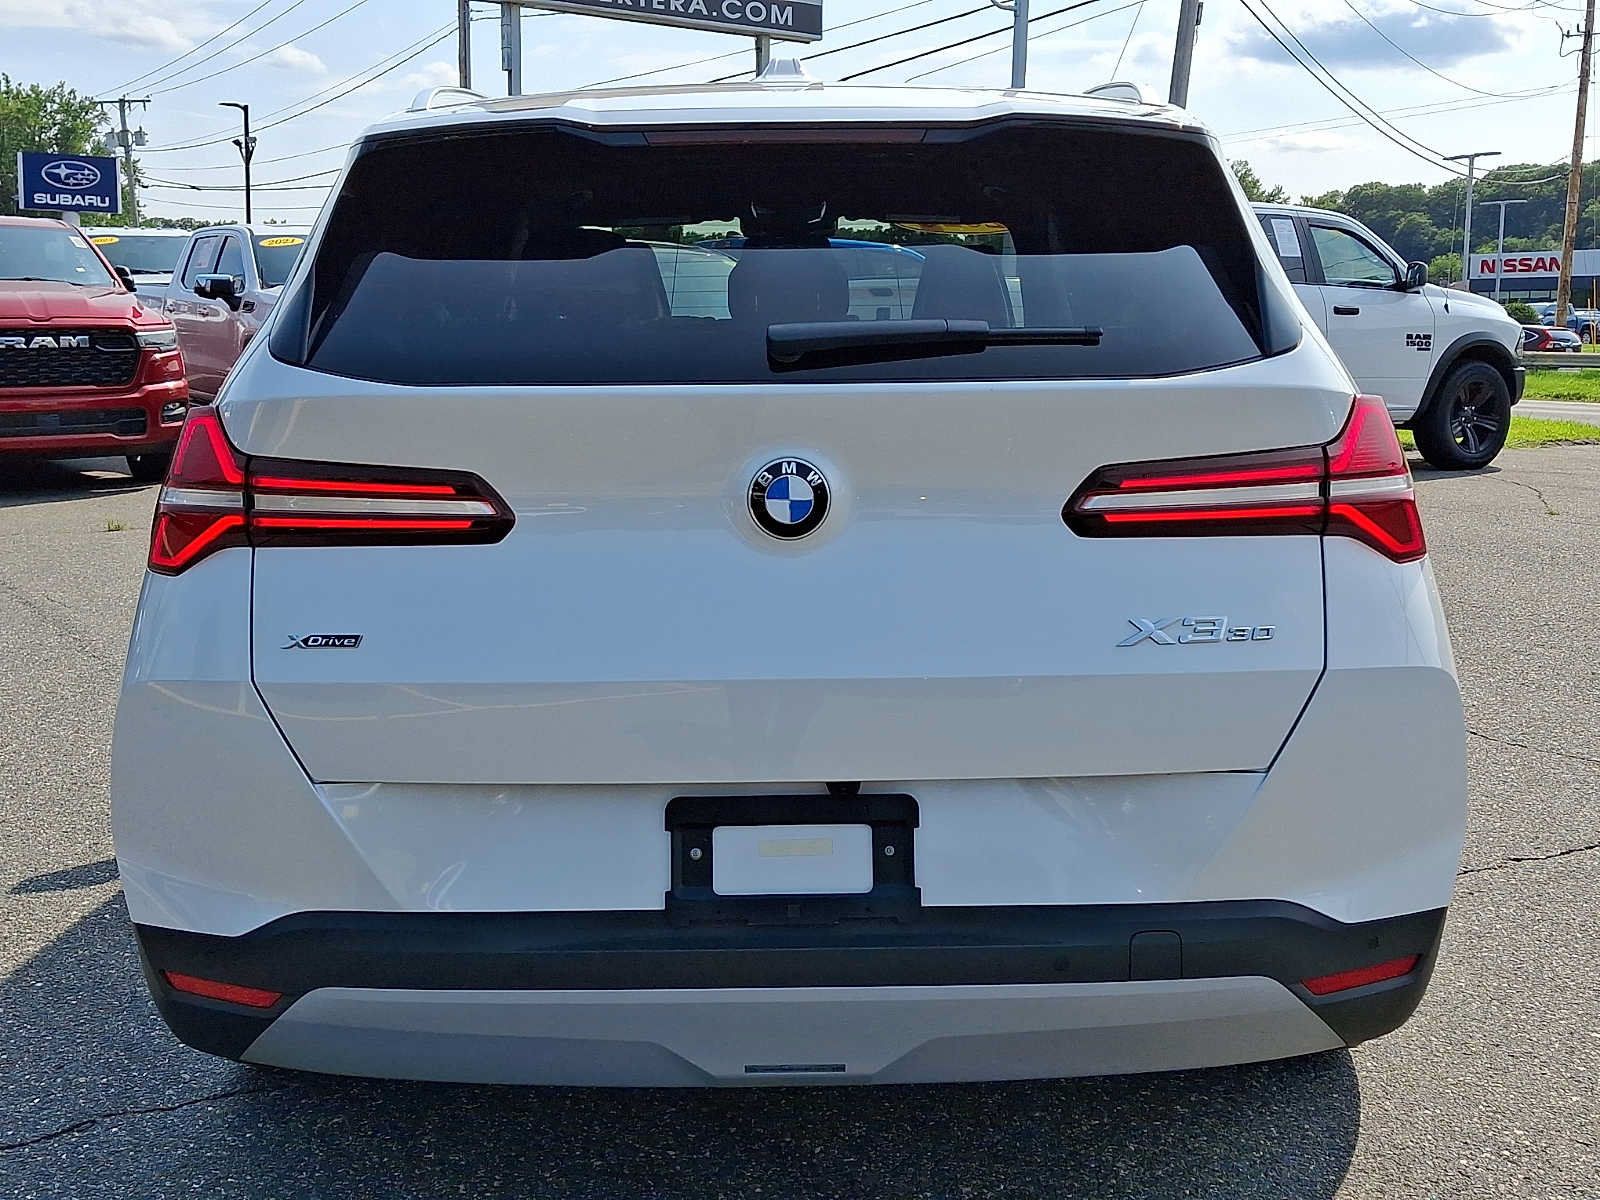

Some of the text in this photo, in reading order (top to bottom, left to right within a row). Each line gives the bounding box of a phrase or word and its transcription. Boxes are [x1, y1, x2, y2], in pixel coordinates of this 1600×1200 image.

[33, 192, 110, 207] SUBARU
[1480, 256, 1561, 274] NSSAN
[0, 335, 90, 349] RAM
[758, 461, 823, 487] BMW
